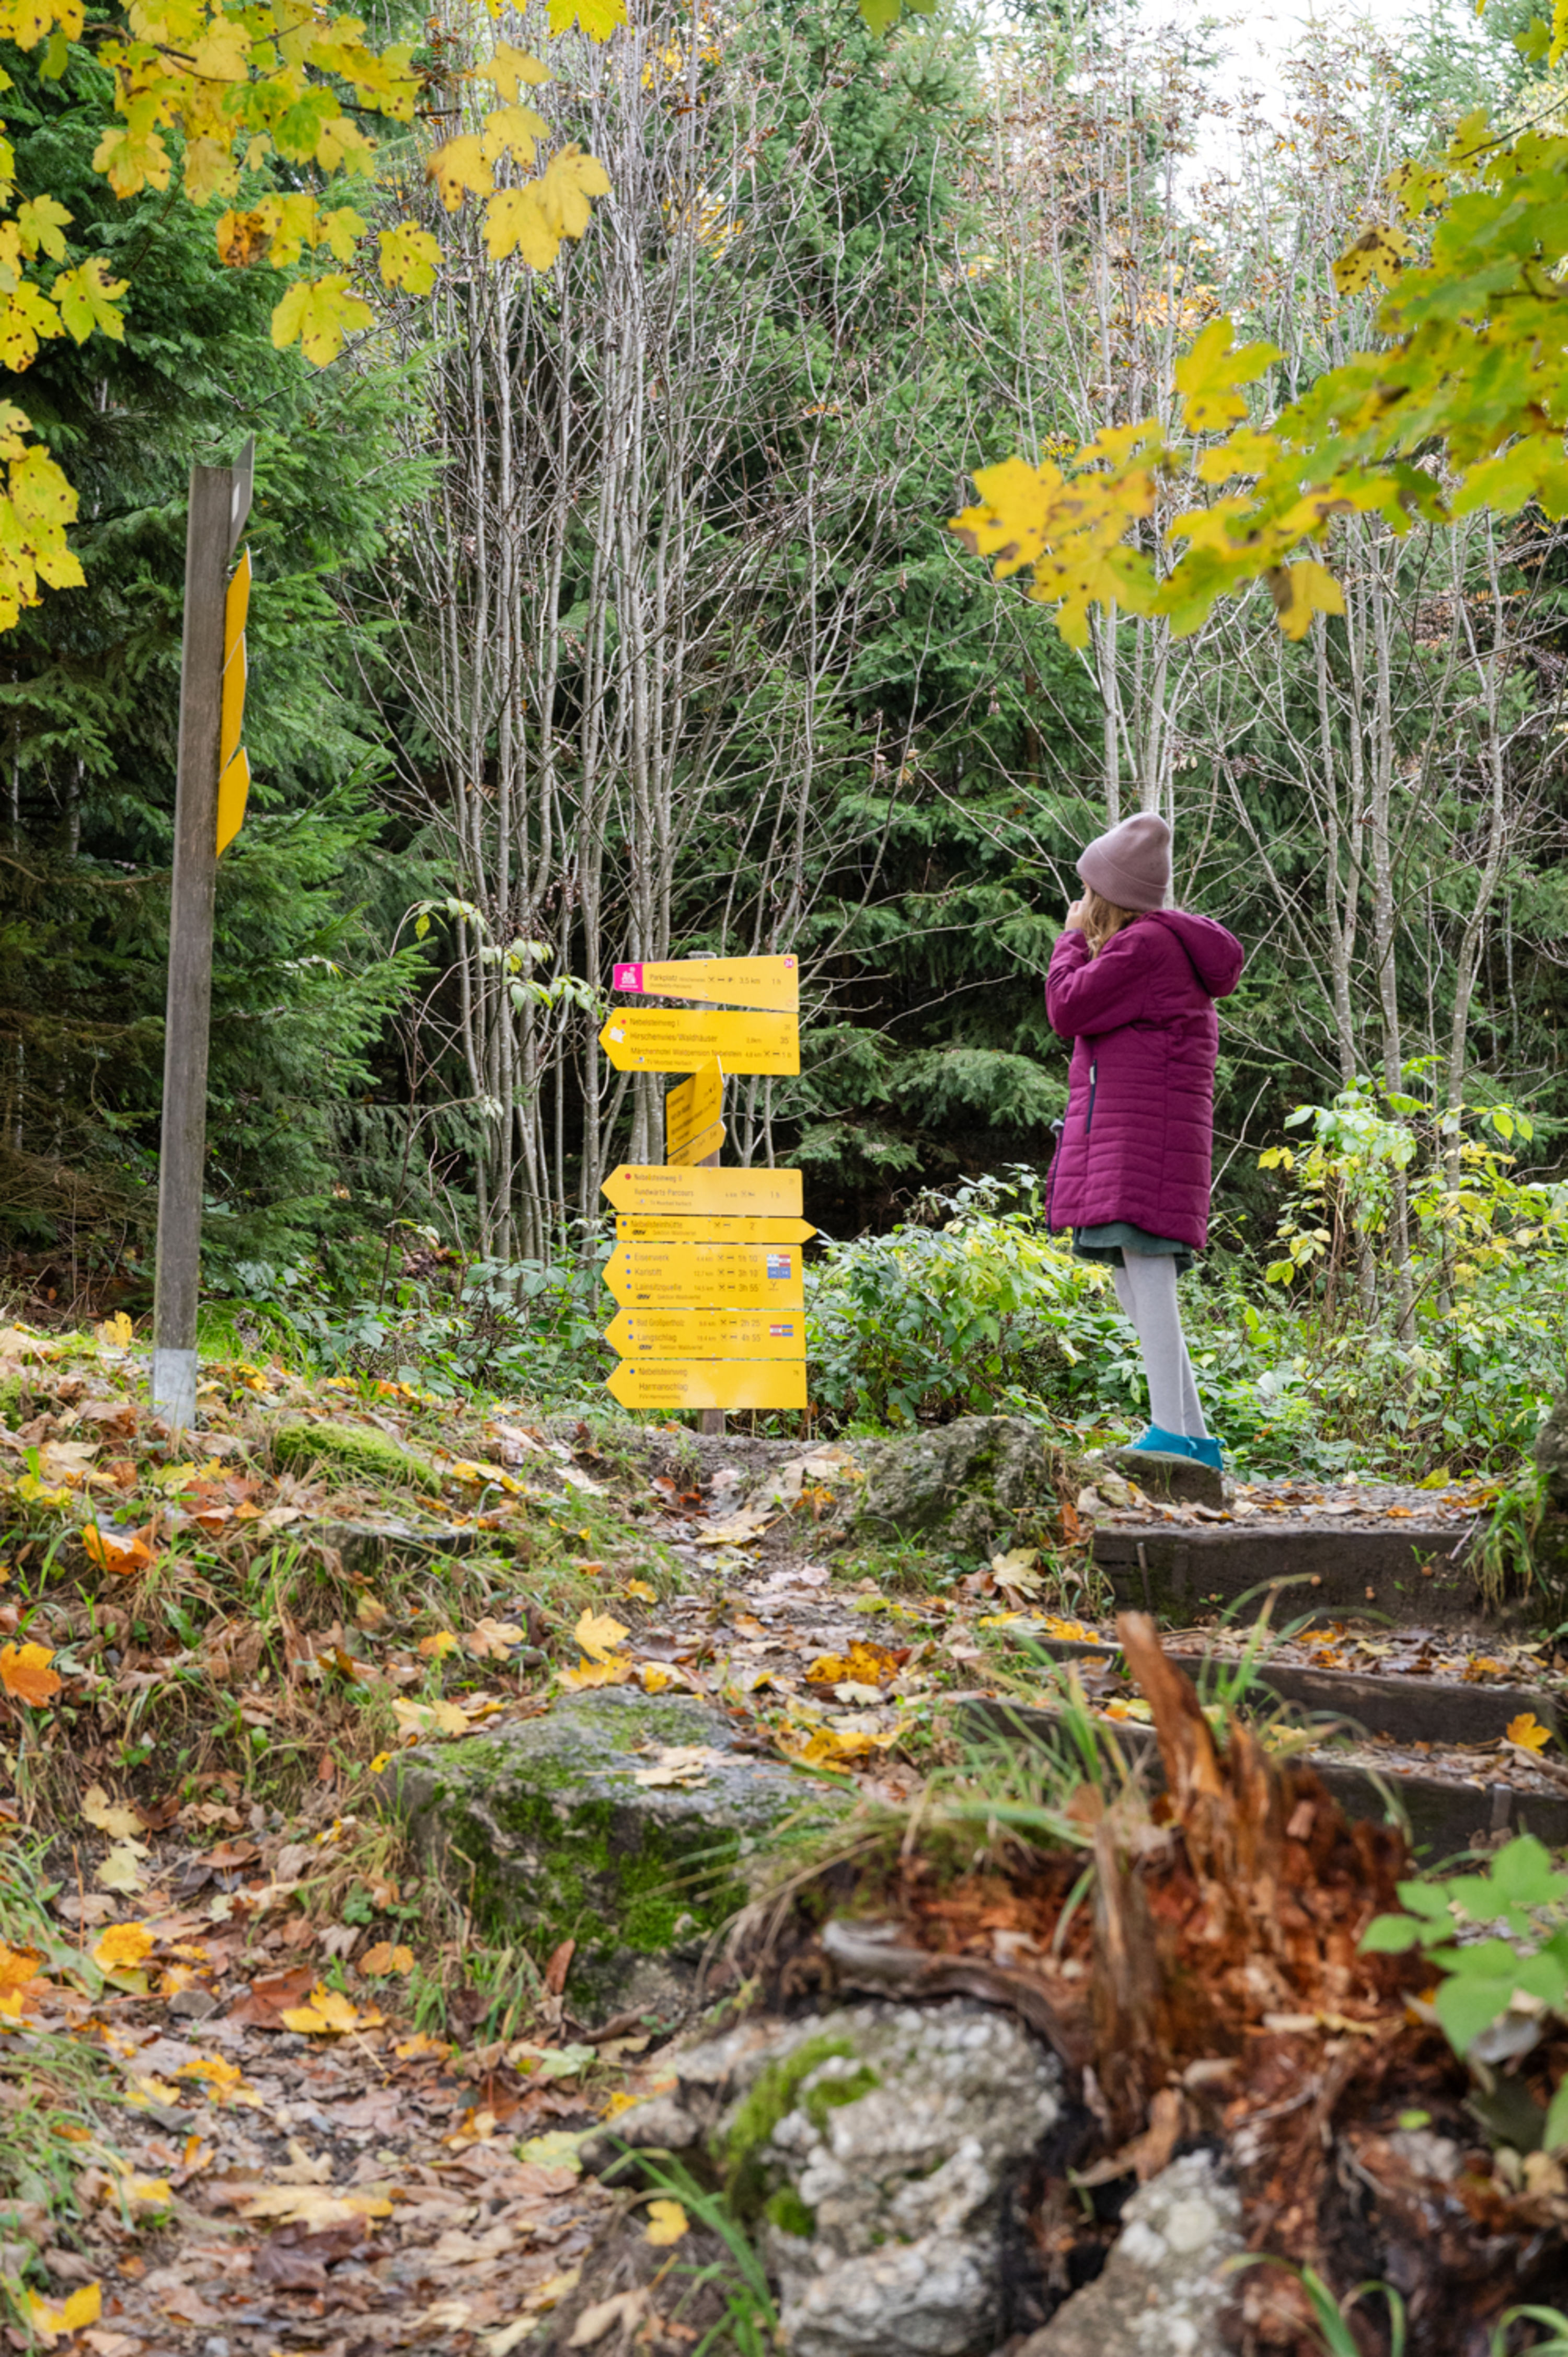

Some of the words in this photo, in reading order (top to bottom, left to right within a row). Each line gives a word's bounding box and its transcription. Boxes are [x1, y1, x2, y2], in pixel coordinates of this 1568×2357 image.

[649, 973, 678, 982] Parkplatz
[630, 1018, 676, 1028] Nebelsteinweg
[630, 1047, 671, 1055] Märchenhotel
[672, 1048, 710, 1056] Waldpension
[634, 1173, 677, 1184] Nebelsteinweg
[630, 1220, 683, 1229] Nebelsteinhütte
[635, 1252, 669, 1261] Eisenwerk
[635, 1268, 662, 1277] Karlstift
[635, 1283, 682, 1292] Lainsitzquelle
[636, 1318, 648, 1327] Bad
[637, 1333, 677, 1343] Langschlag
[638, 1367, 688, 1377] Nebelsteinweg
[639, 1382, 688, 1393] Harmanschlag
